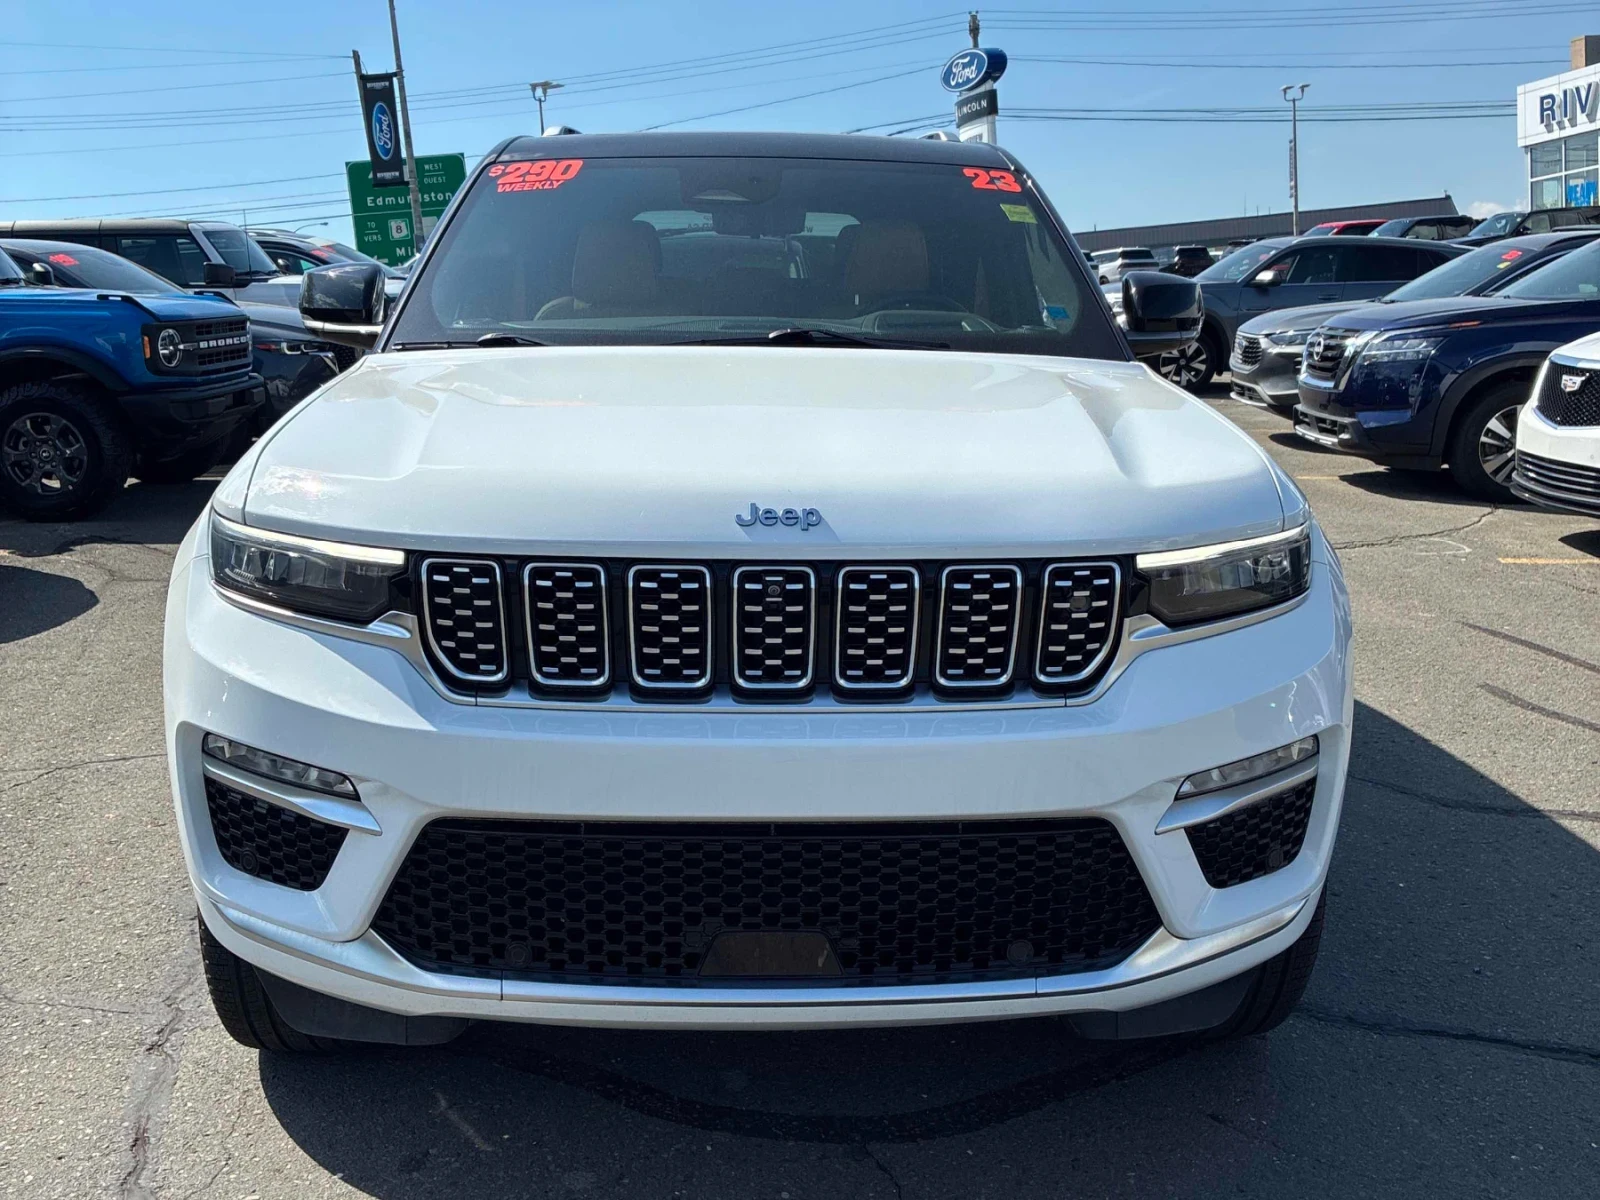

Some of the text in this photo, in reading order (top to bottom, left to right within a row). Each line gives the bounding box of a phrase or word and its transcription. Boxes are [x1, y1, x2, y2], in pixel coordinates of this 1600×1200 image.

[950, 56, 978, 86] Ford
[958, 99, 987, 117] LINCOLN
[376, 114, 391, 148] Ford
[424, 163, 443, 171] WEST
[488, 160, 584, 184] $290
[424, 176, 446, 184] OUEST
[497, 180, 564, 193] WEEKLY
[962, 168, 1022, 193] 23
[366, 191, 453, 207] Edmunston
[366, 221, 376, 229] TO
[395, 224, 403, 234] 8
[363, 234, 382, 242] VERS
[199, 336, 247, 349] BRONCO
[735, 502, 822, 532] Jeep
